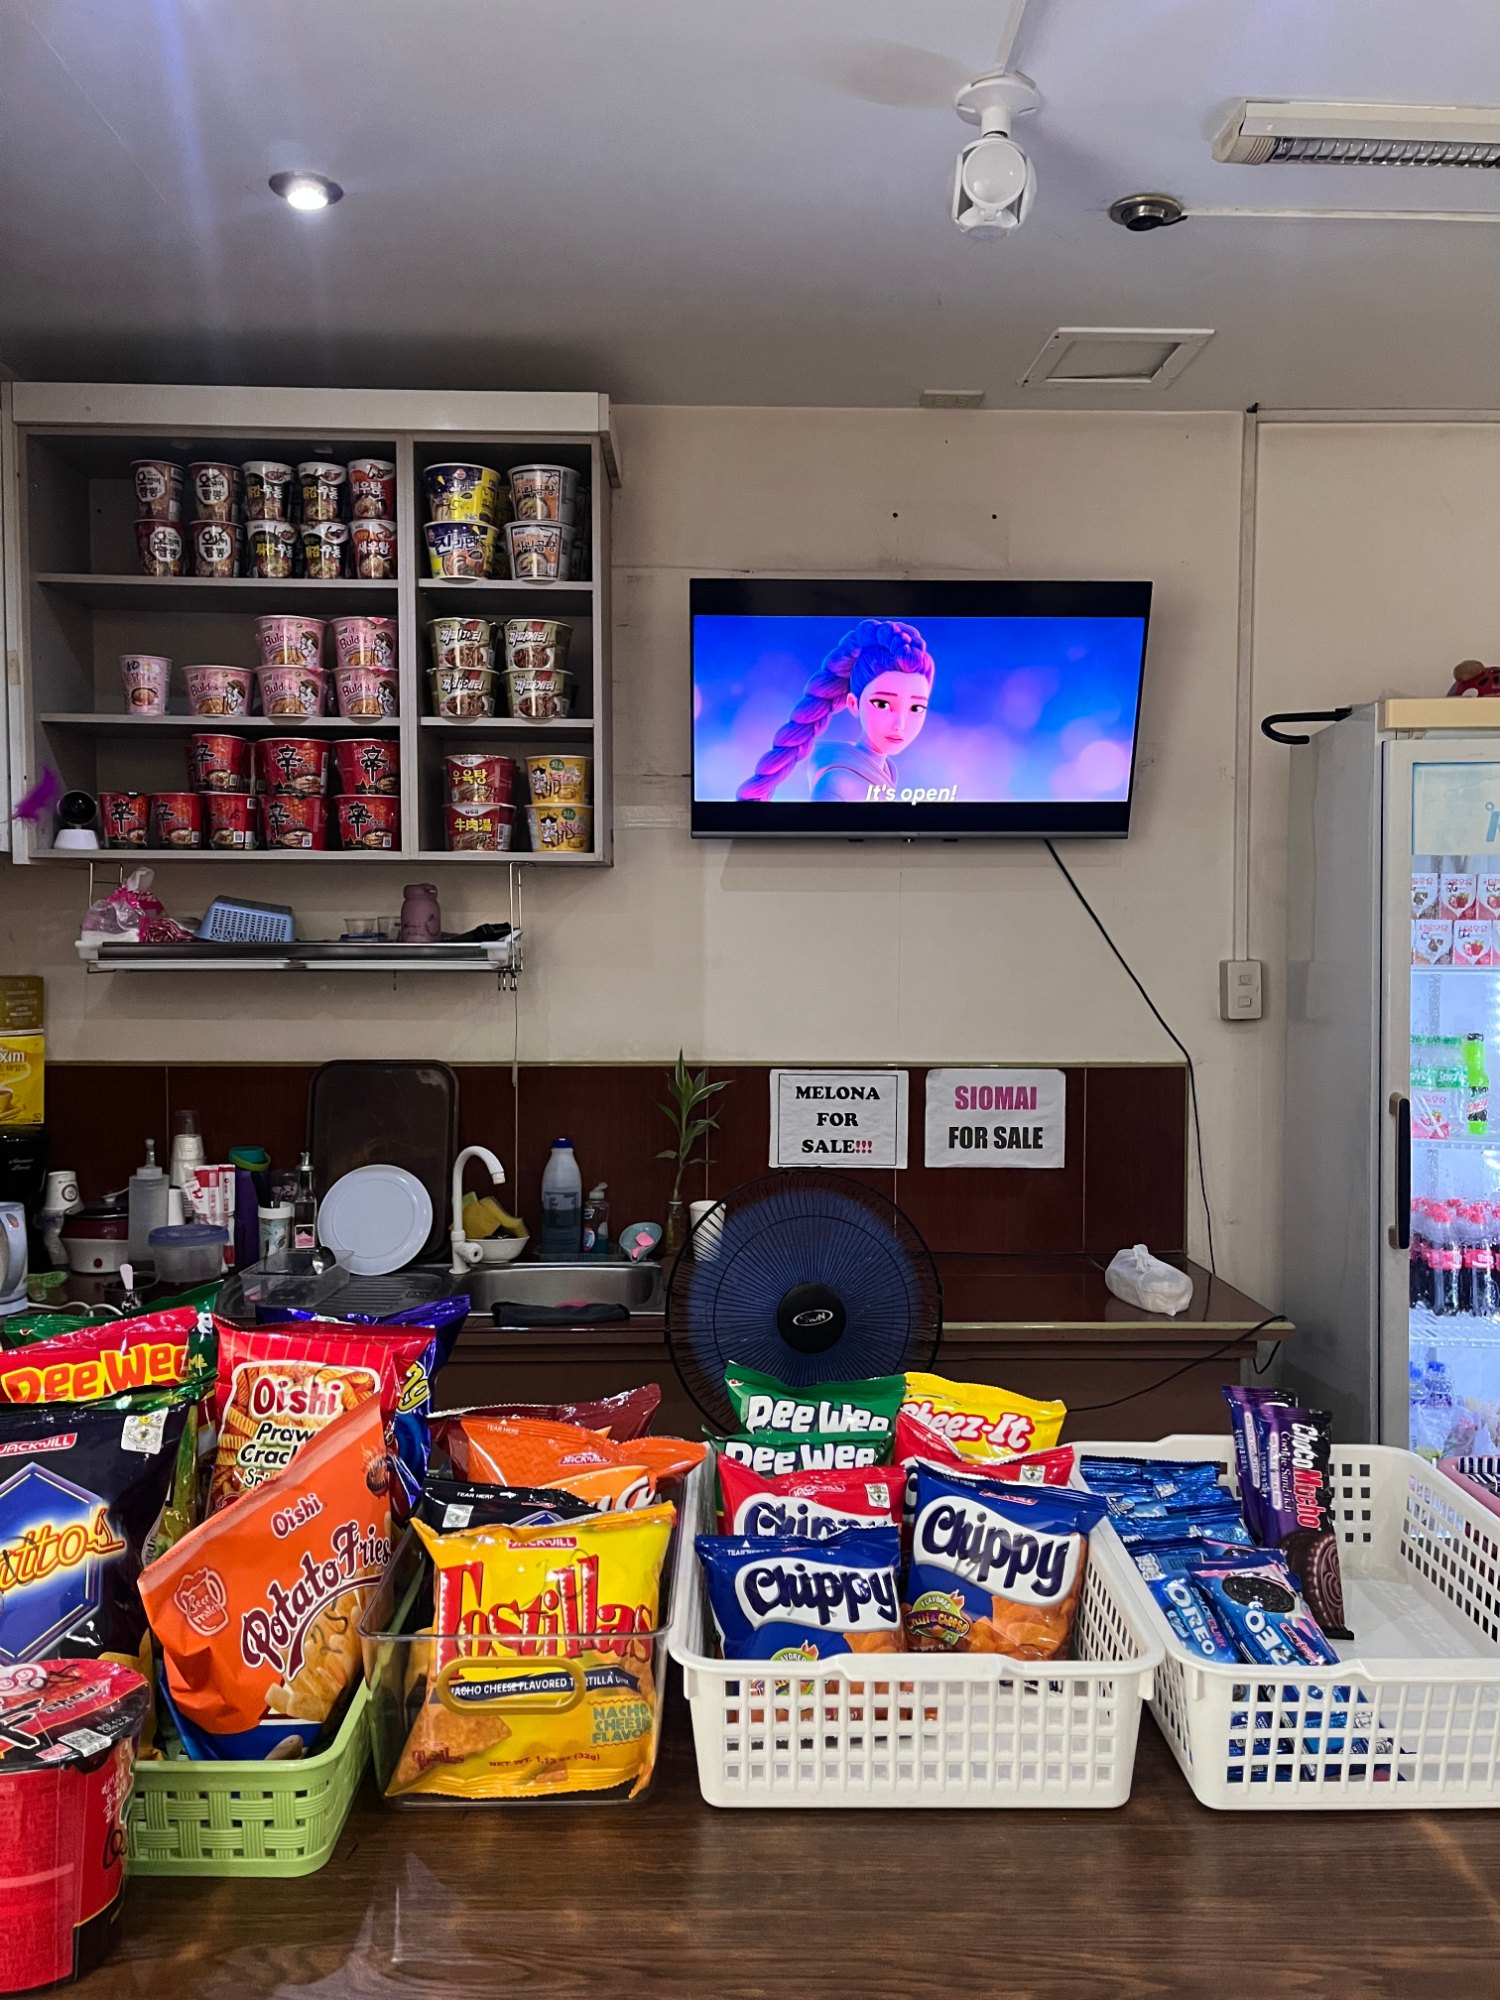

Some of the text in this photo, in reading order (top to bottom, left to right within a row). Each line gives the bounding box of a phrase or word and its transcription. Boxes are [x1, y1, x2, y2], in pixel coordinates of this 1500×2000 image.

[452, 769, 488, 785] 우육탕
[866, 784, 958, 806] It's open!
[0, 1051, 25, 1063] xim
[795, 1086, 880, 1100] MELONA
[954, 1085, 1037, 1111] SIOMAI
[816, 1112, 859, 1127] FOR
[801, 1139, 873, 1154] SALE!!!
[949, 1126, 1044, 1150] FOR SALE
[253, 1376, 342, 1417] Oishi
[256, 1422, 317, 1443] Praw
[487, 1423, 501, 1433] TEAR
[272, 1494, 322, 1538] Oishi
[0, 1508, 126, 1592] ttos
[921, 1503, 1071, 1597] Chippy
[241, 1520, 393, 1672] Potato Fries
[743, 1563, 898, 1626] Chippy
[920, 1596, 952, 1610] FLAVORED
[435, 1554, 654, 1681] Tostillas
[938, 1613, 968, 1633] Cheese
[1165, 1578, 1216, 1656] OREO
[1244, 1608, 1291, 1665] REO
[519, 1677, 568, 1692] FLAVORED
[570, 1674, 614, 1688] TTILLA
[592, 1706, 650, 1720] NACHO
